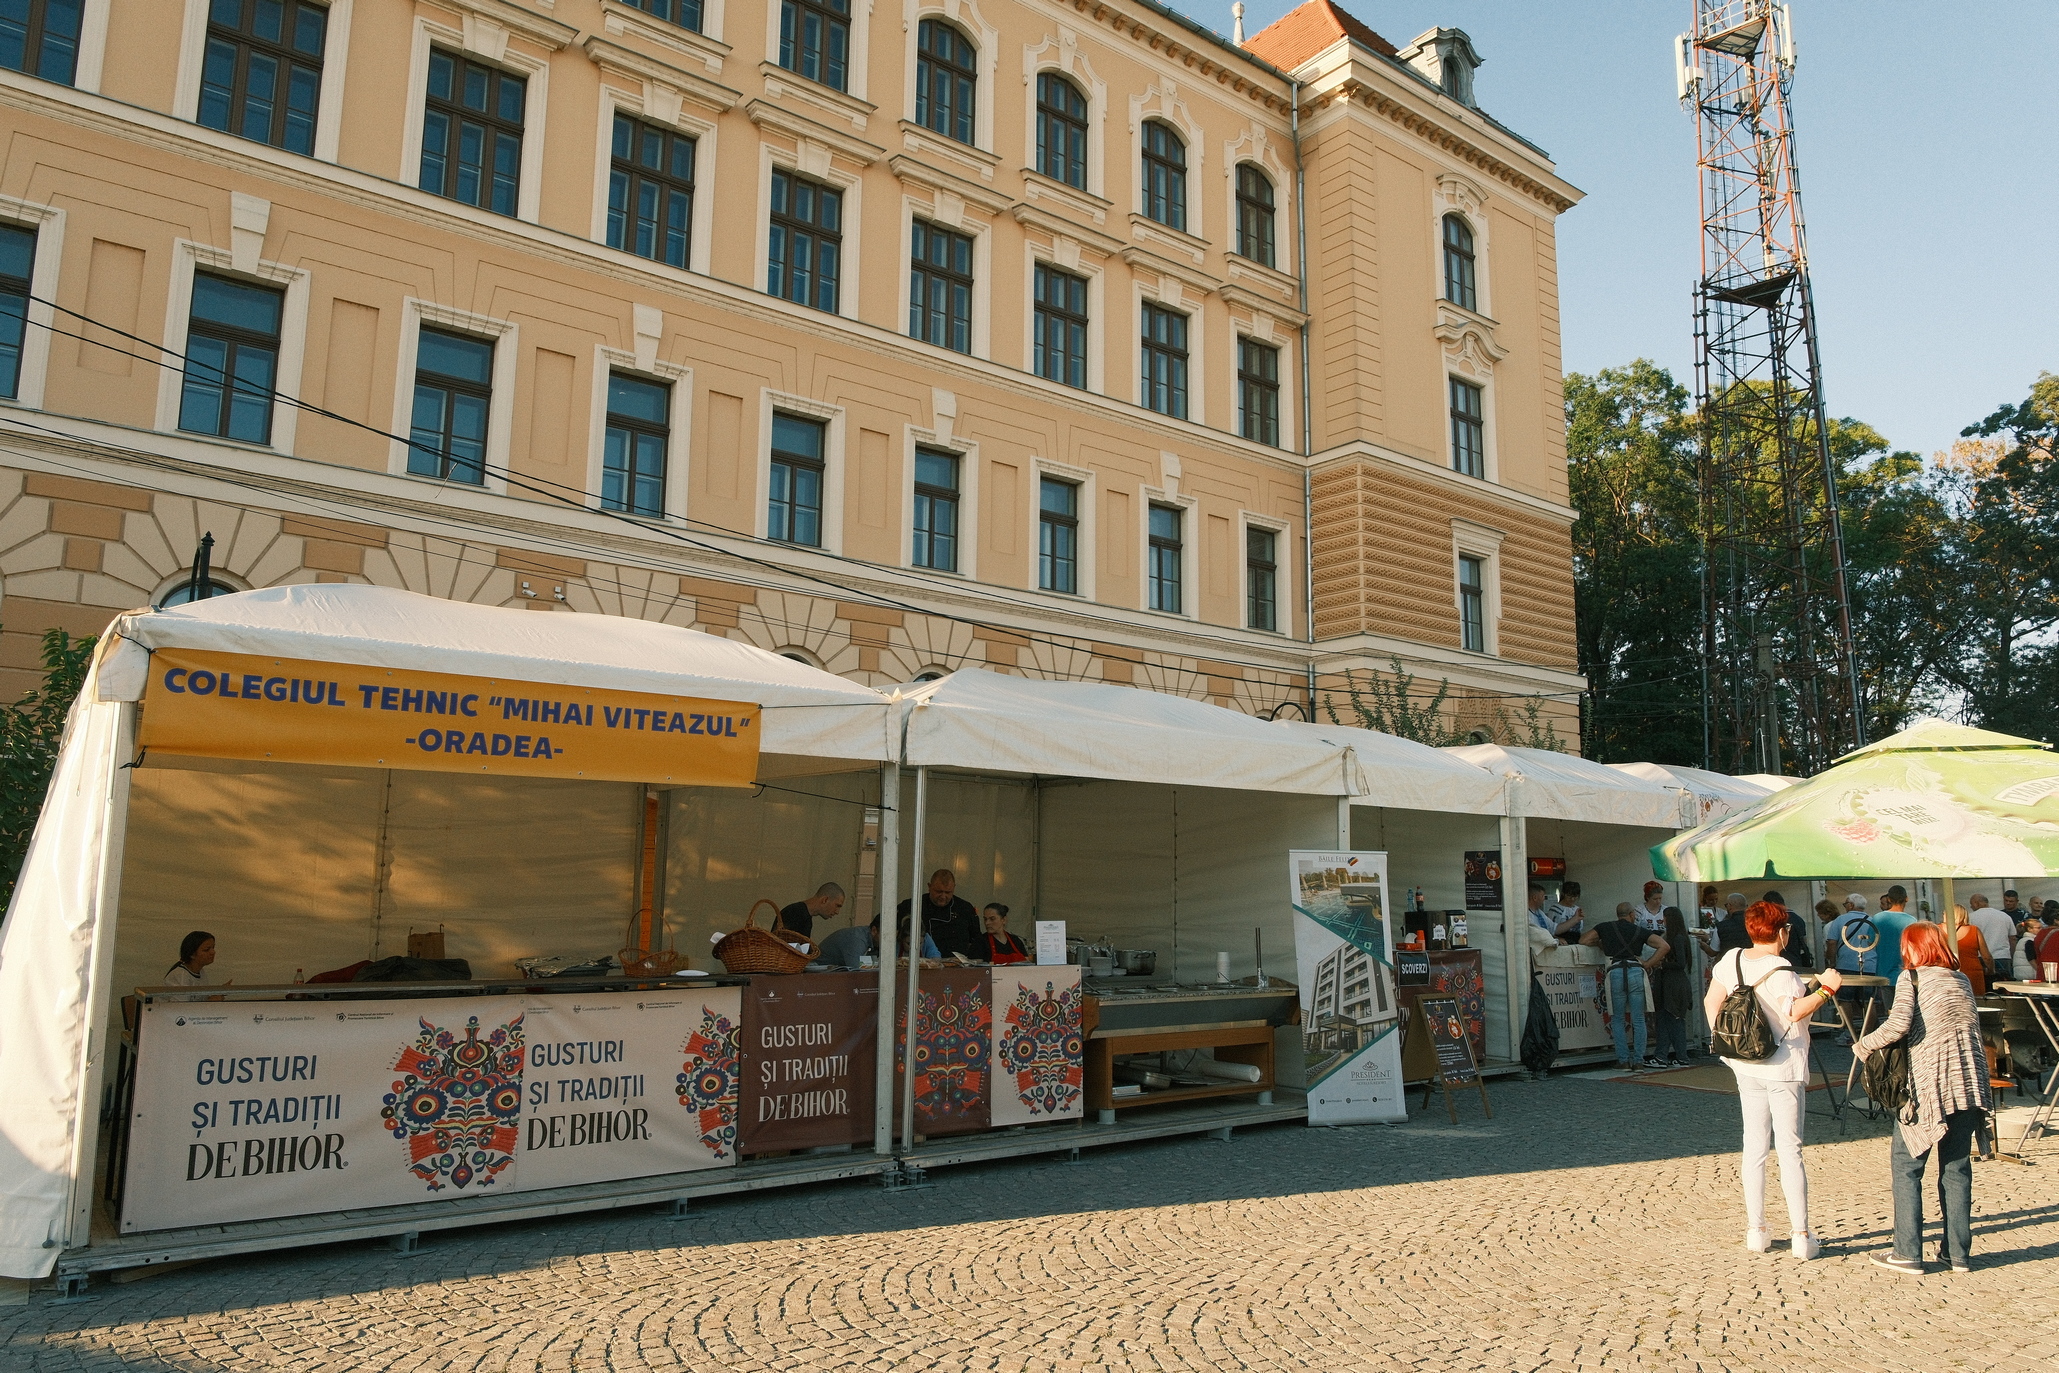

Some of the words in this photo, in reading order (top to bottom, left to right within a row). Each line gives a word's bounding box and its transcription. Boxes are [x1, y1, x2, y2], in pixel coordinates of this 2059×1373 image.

[164, 667, 346, 706] COLEGIUL
[358, 684, 480, 717] TEHNIC
[405, 728, 564, 760] -ORADEA-
[1875, 807, 1903, 816] CEL
[1899, 804, 1927, 813] MAI
[1895, 811, 1931, 820] TARE
[1909, 816, 1941, 826] MIX!
[1401, 963, 1428, 975] SCOVERZI
[1545, 972, 1575, 986] GUSTURI
[1560, 1009, 1588, 1029] BIHOR
[761, 1023, 832, 1048] GUSTURI
[531, 1040, 624, 1068] GUSTURI
[196, 1055, 317, 1086] GUSTURI
[761, 1060, 777, 1089] ȘI
[782, 1055, 849, 1083] TRADIȚII
[1351, 1070, 1391, 1079] PRESIDENT
[529, 1081, 549, 1113] ȘI
[557, 1074, 644, 1105] TRADIȚII
[758, 1094, 788, 1122] DE
[789, 1088, 848, 1119] BIHOR
[191, 1101, 218, 1138] ȘI
[229, 1094, 341, 1130] TRADIȚII
[527, 1115, 566, 1151] DE
[569, 1108, 650, 1147] BIHOR
[186, 1141, 238, 1181] DE
[242, 1133, 345, 1177] BIHOR
